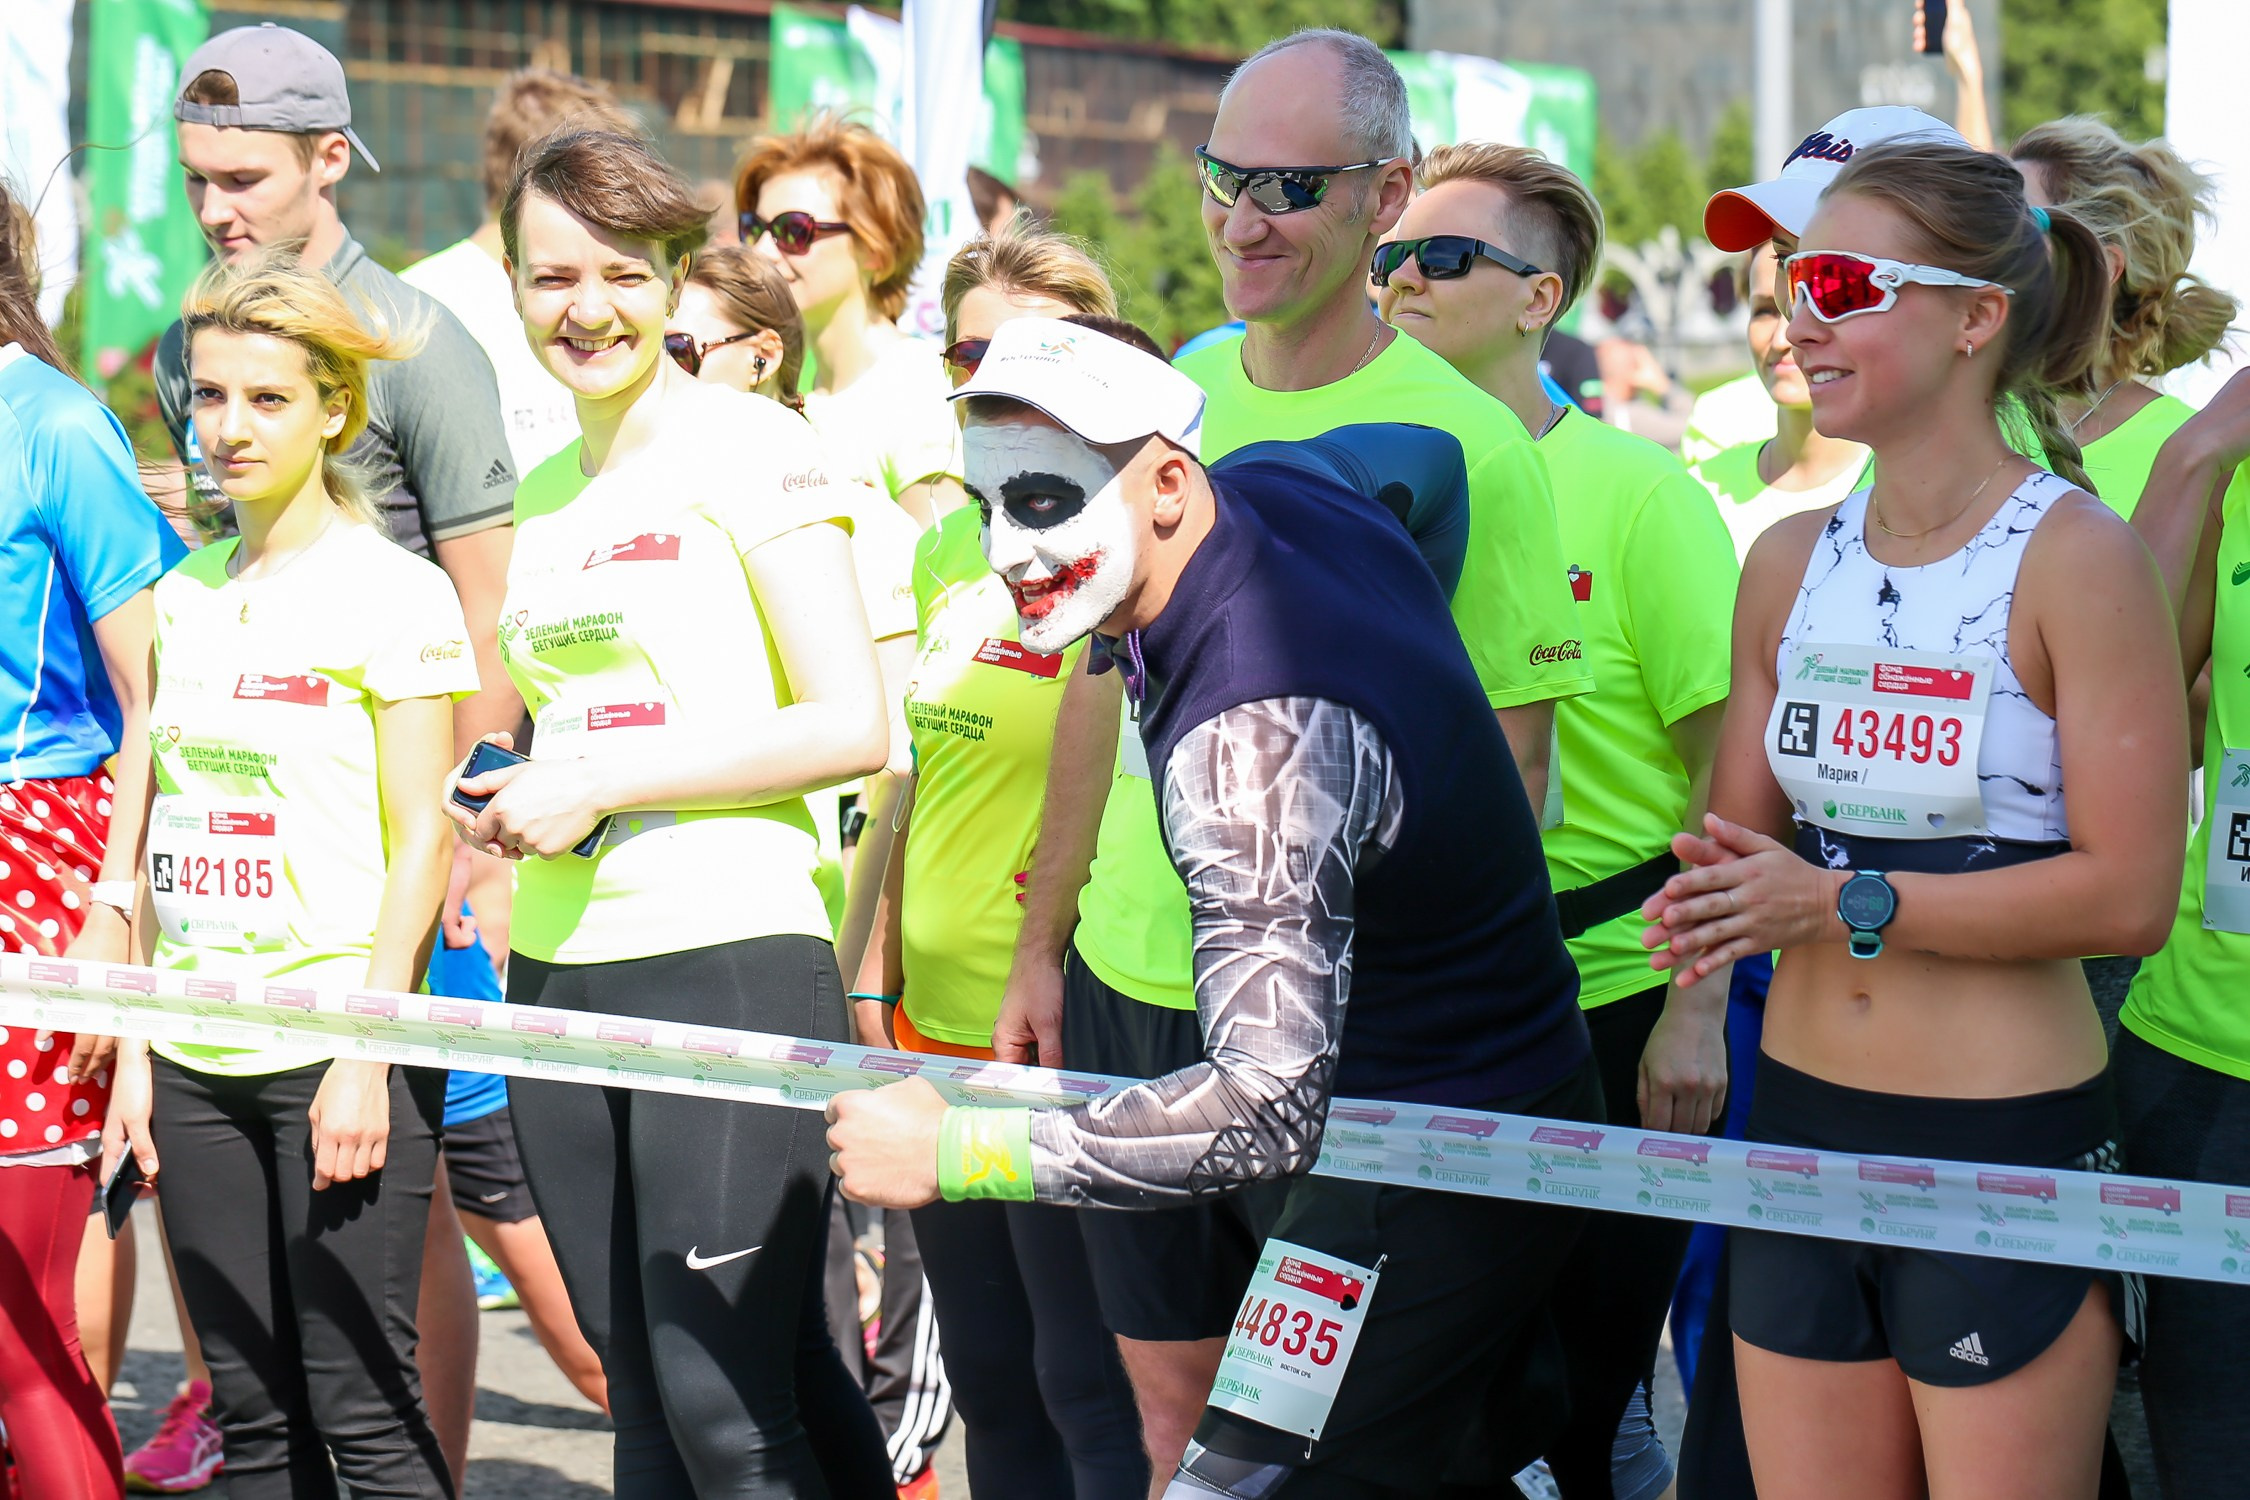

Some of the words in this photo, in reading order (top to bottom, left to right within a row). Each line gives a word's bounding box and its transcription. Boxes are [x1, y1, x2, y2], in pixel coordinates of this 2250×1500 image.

[525, 616, 570, 641] ЗЕЛЕНЫЙ
[572, 612, 623, 630] МАРАФОН
[532, 631, 577, 653] БЕГУЩИЕ
[579, 626, 619, 643] СЕРДЦА
[1529, 639, 1582, 666] Coca-Cola
[911, 702, 946, 717] ЗЕЛЕНЫЙ
[949, 707, 993, 729] МАРАФОН
[914, 716, 948, 733] БЕГУЩИЕ
[950, 723, 985, 742] СЕРДЦА
[1832, 708, 1963, 767] 43493
[179, 746, 225, 760] ЗЕЛЕНЫЙ
[228, 750, 277, 766] МАРАФОН
[187, 759, 231, 775] БЕГУЩИЕ
[1817, 763, 1858, 785] Мария
[1839, 802, 1908, 822] СБЕРБАНК
[179, 856, 273, 899] 42185
[191, 919, 239, 931] СБЕРБАНК
[1234, 1346, 1275, 1367] СБЕРБАНК
[1949, 1346, 1989, 1366] adidas
